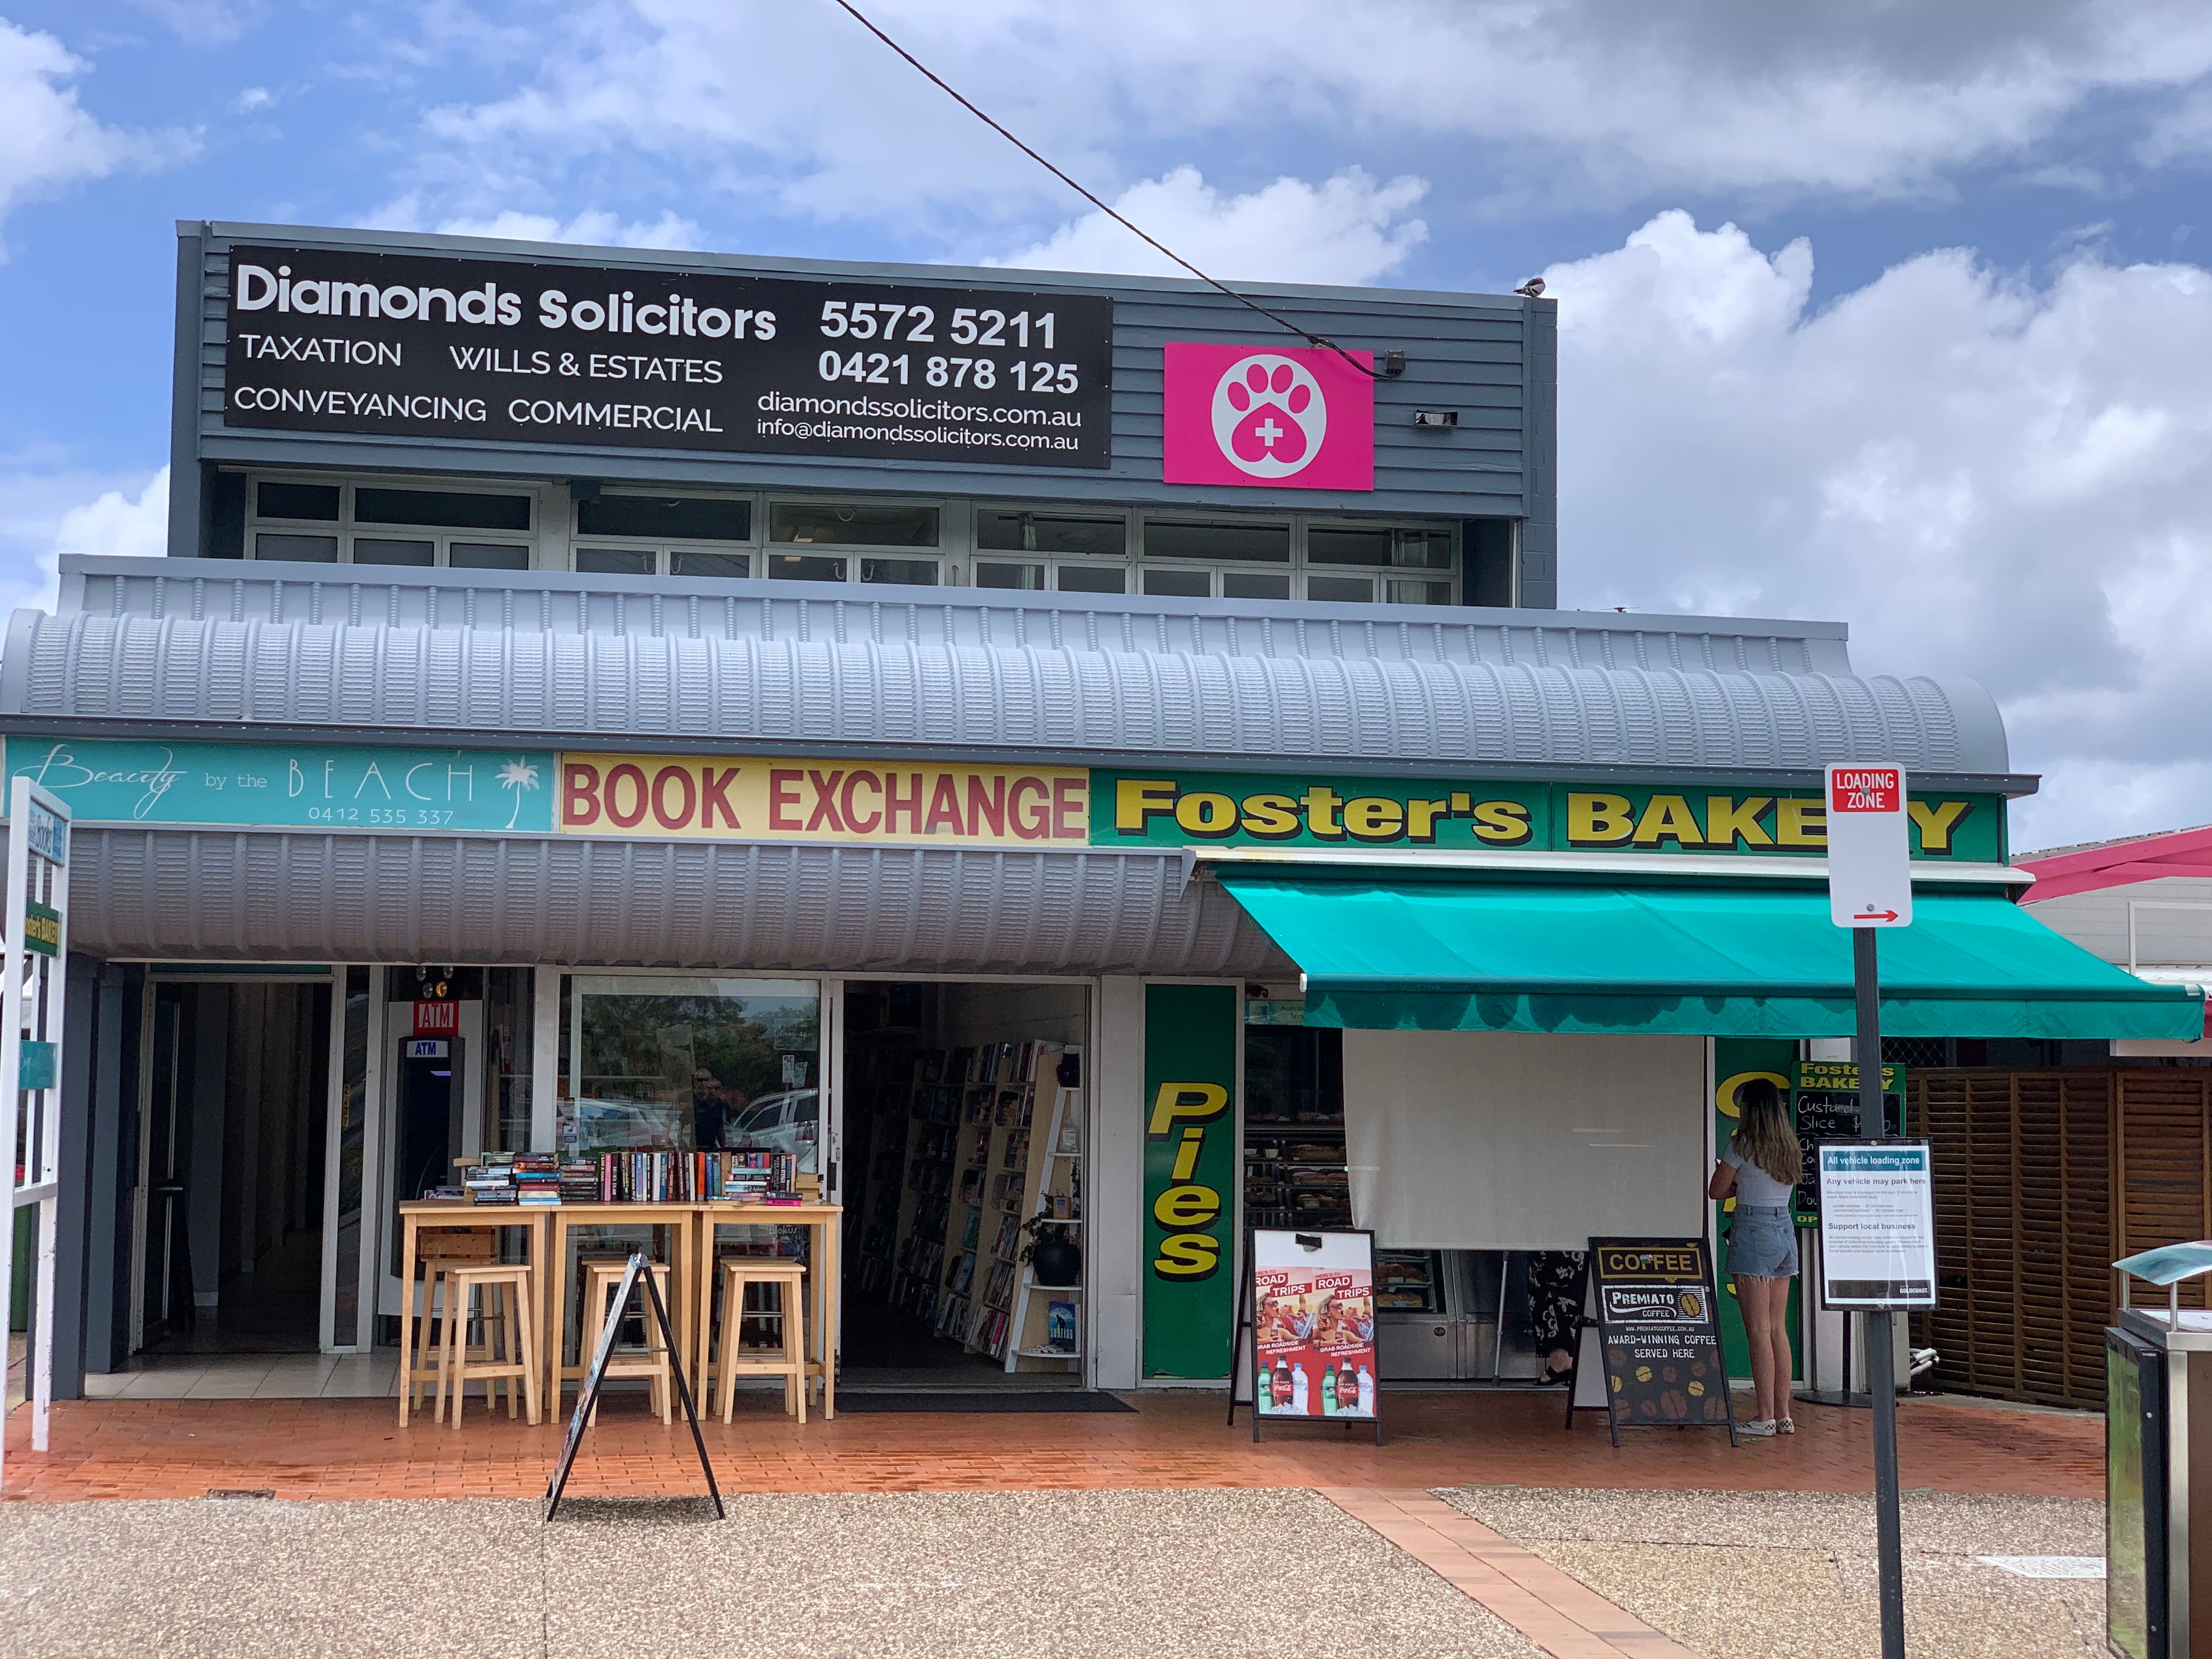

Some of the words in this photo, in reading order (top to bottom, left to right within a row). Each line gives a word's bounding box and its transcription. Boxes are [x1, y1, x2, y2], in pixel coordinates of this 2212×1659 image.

[237, 264, 521, 326] Diamonds
[539, 290, 776, 341] Solicitors
[820, 301, 934, 343] 5572
[951, 308, 1055, 349] 5211
[239, 334, 402, 366] TAXATION
[449, 346, 551, 375] WILLS
[558, 353, 580, 377] &
[590, 354, 723, 384] ESTATES
[819, 350, 910, 385] 0421
[926, 357, 996, 390] 878
[1011, 361, 1079, 394] 125
[234, 387, 486, 422] CONVEYANCING
[509, 400, 723, 433] COMMERCIAL
[758, 391, 1082, 427] diamondssolicitors.com.au
[757, 419, 1079, 450] info@diamondssolicitors.com.au
[12, 743, 187, 819] Beauty
[205, 772, 224, 789] by
[237, 774, 268, 788] the
[289, 759, 473, 802] BEACH
[1837, 772, 1894, 789] LOADING
[563, 763, 741, 830] BOOK
[769, 769, 1086, 840] EXCHANGE
[1847, 792, 1884, 809] ZONE
[308, 807, 358, 821] 0412
[371, 810, 407, 823] 535
[416, 810, 453, 825] 337
[1115, 778, 1532, 844] Foster's
[1567, 793, 1971, 852] BAKEY
[422, 1003, 450, 1028] ATM
[415, 1042, 436, 1056] ATM
[1801, 1063, 1894, 1076] Fostes
[1801, 1076, 1894, 1090] BAKEY
[1799, 1115, 1836, 1130] Slice
[1870, 1156, 1899, 1166] loading
[1148, 1081, 1229, 1282] Pies
[1256, 1274, 1286, 1285] ROAD
[1318, 1277, 1350, 1288] ROAD
[1273, 1285, 1305, 1296] TRIPS
[1338, 1288, 1369, 1299] TRIPS
[1608, 1335, 1680, 1345] AWARD-WINNING
[1684, 1335, 1717, 1345] COFFEE
[1266, 1345, 1306, 1355] REFRESHMENT
[1330, 1348, 1371, 1357] REFRESHMENT
[1634, 1349, 1668, 1358] SERVED
[1673, 1349, 1695, 1358] HERE
